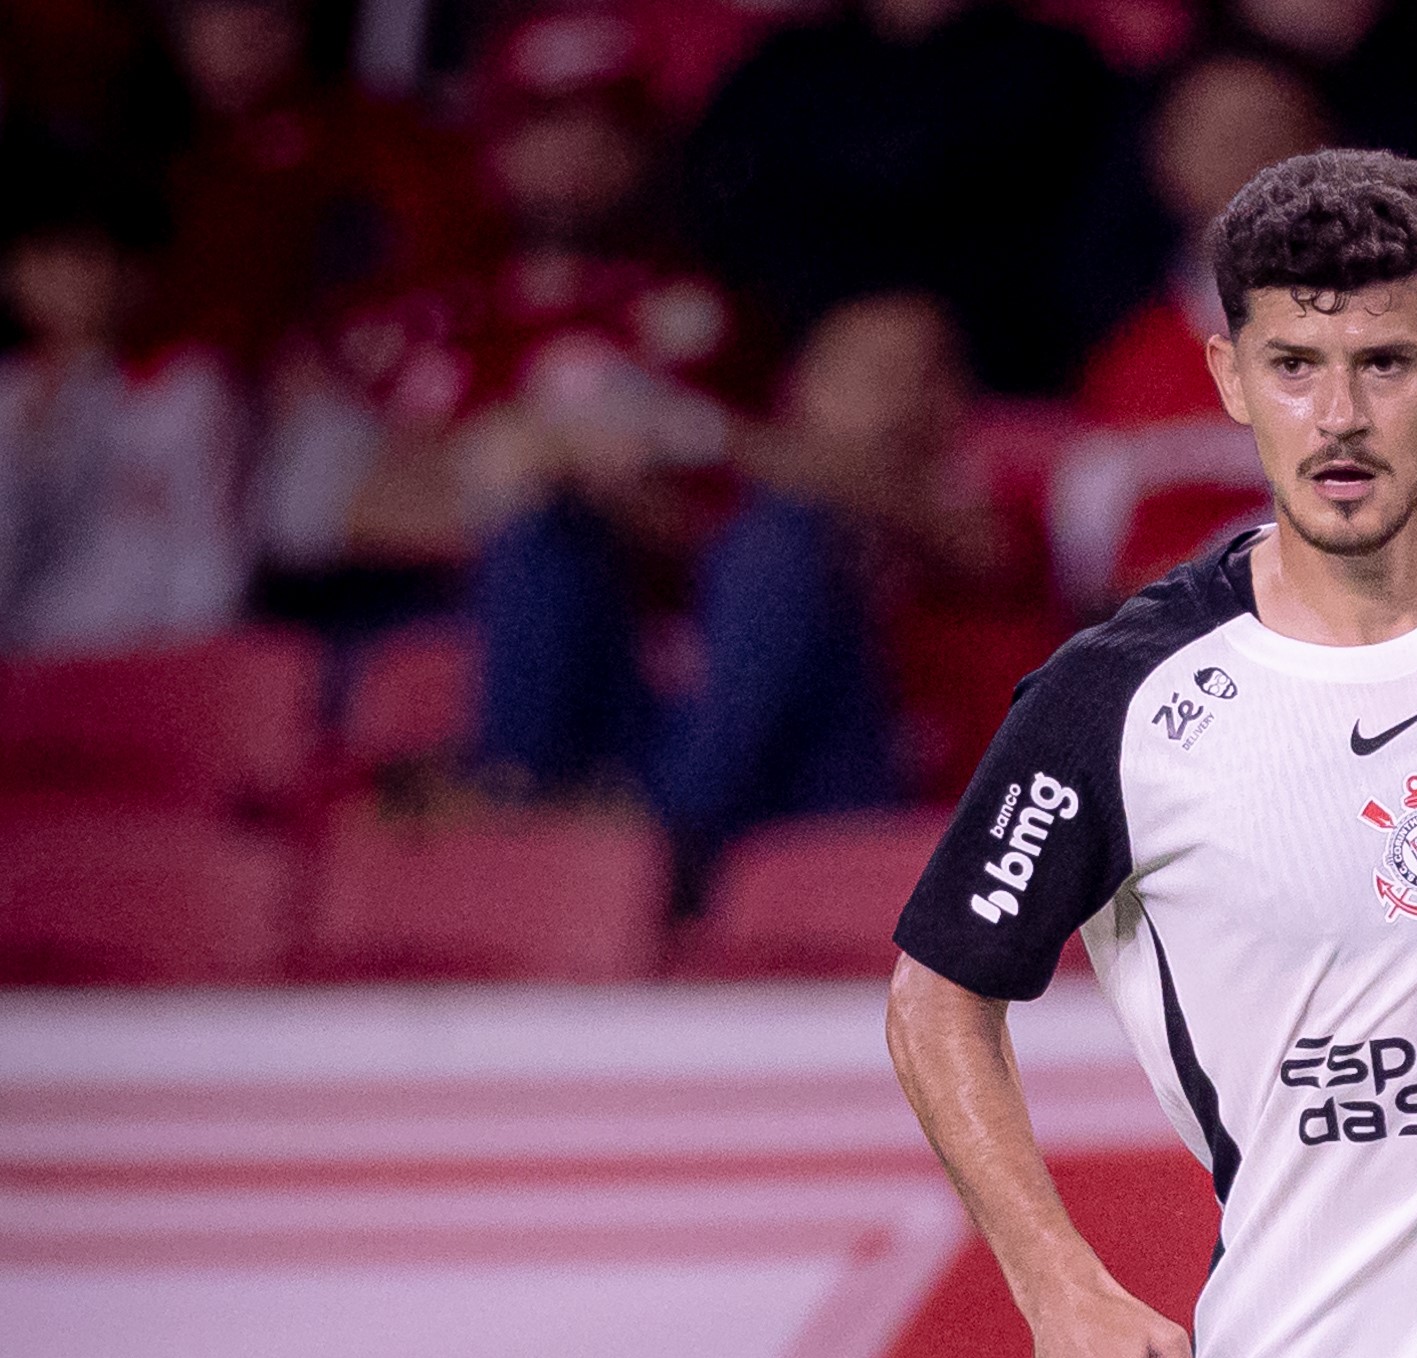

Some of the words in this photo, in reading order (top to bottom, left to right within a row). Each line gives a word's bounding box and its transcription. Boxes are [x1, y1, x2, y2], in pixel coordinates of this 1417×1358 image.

[1181, 711, 1215, 751] DELIVERY
[984, 771, 1079, 892] bmg
[990, 783, 1021, 839] banco
